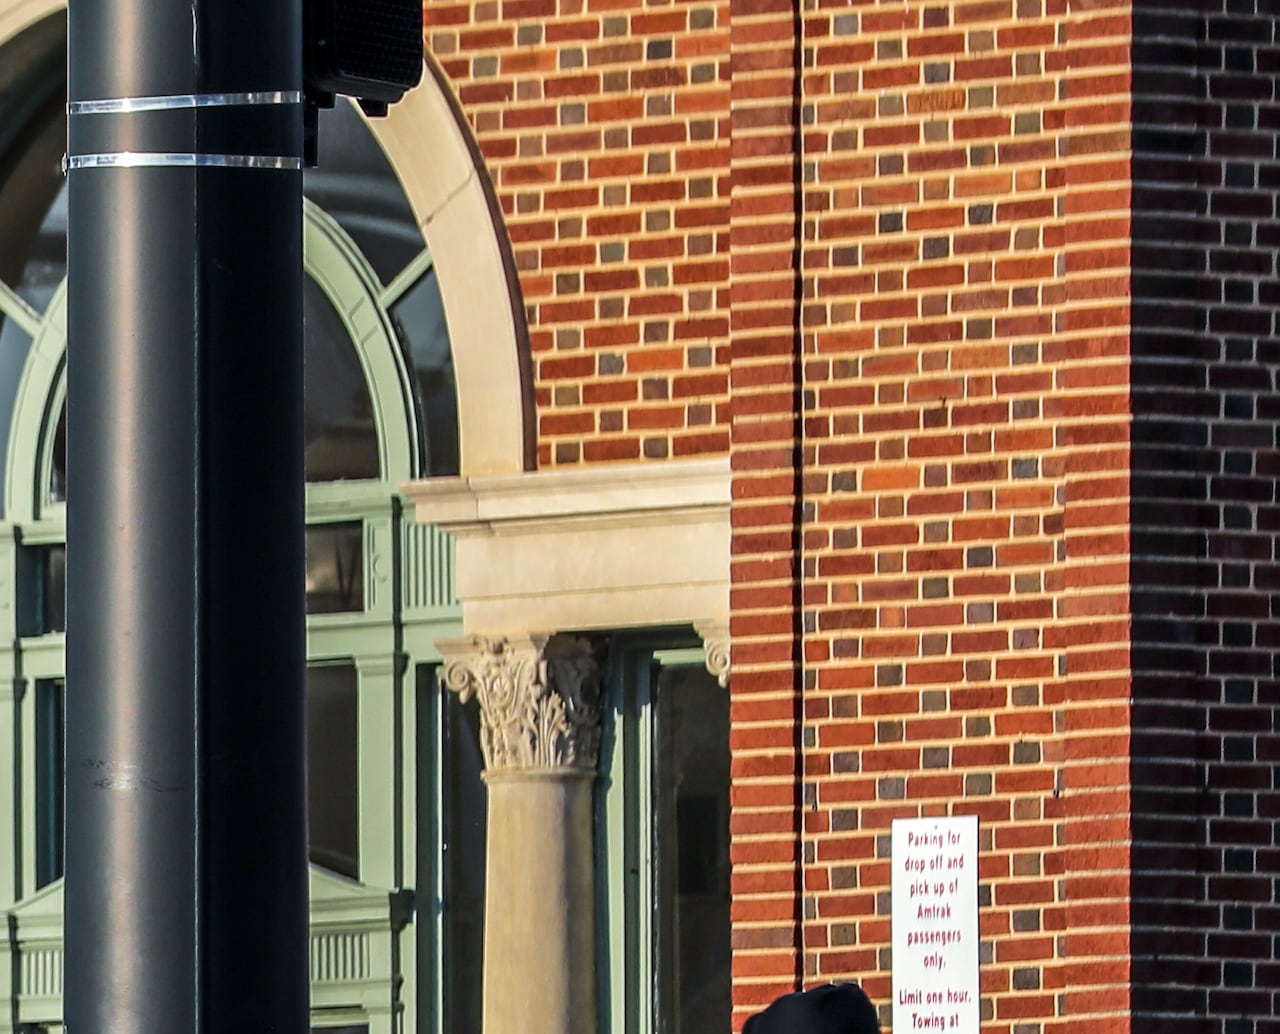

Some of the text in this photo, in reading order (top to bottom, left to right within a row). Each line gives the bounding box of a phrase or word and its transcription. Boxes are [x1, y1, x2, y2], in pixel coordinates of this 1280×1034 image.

[908, 828, 961, 850] Parking for
[904, 852, 965, 874] drop off and
[910, 876, 959, 899] pick up of
[917, 903, 952, 920] Amtrak
[907, 929, 962, 947] passengers
[899, 986, 972, 1005] Limit one hour.
[912, 1011, 959, 1031] Towing at
